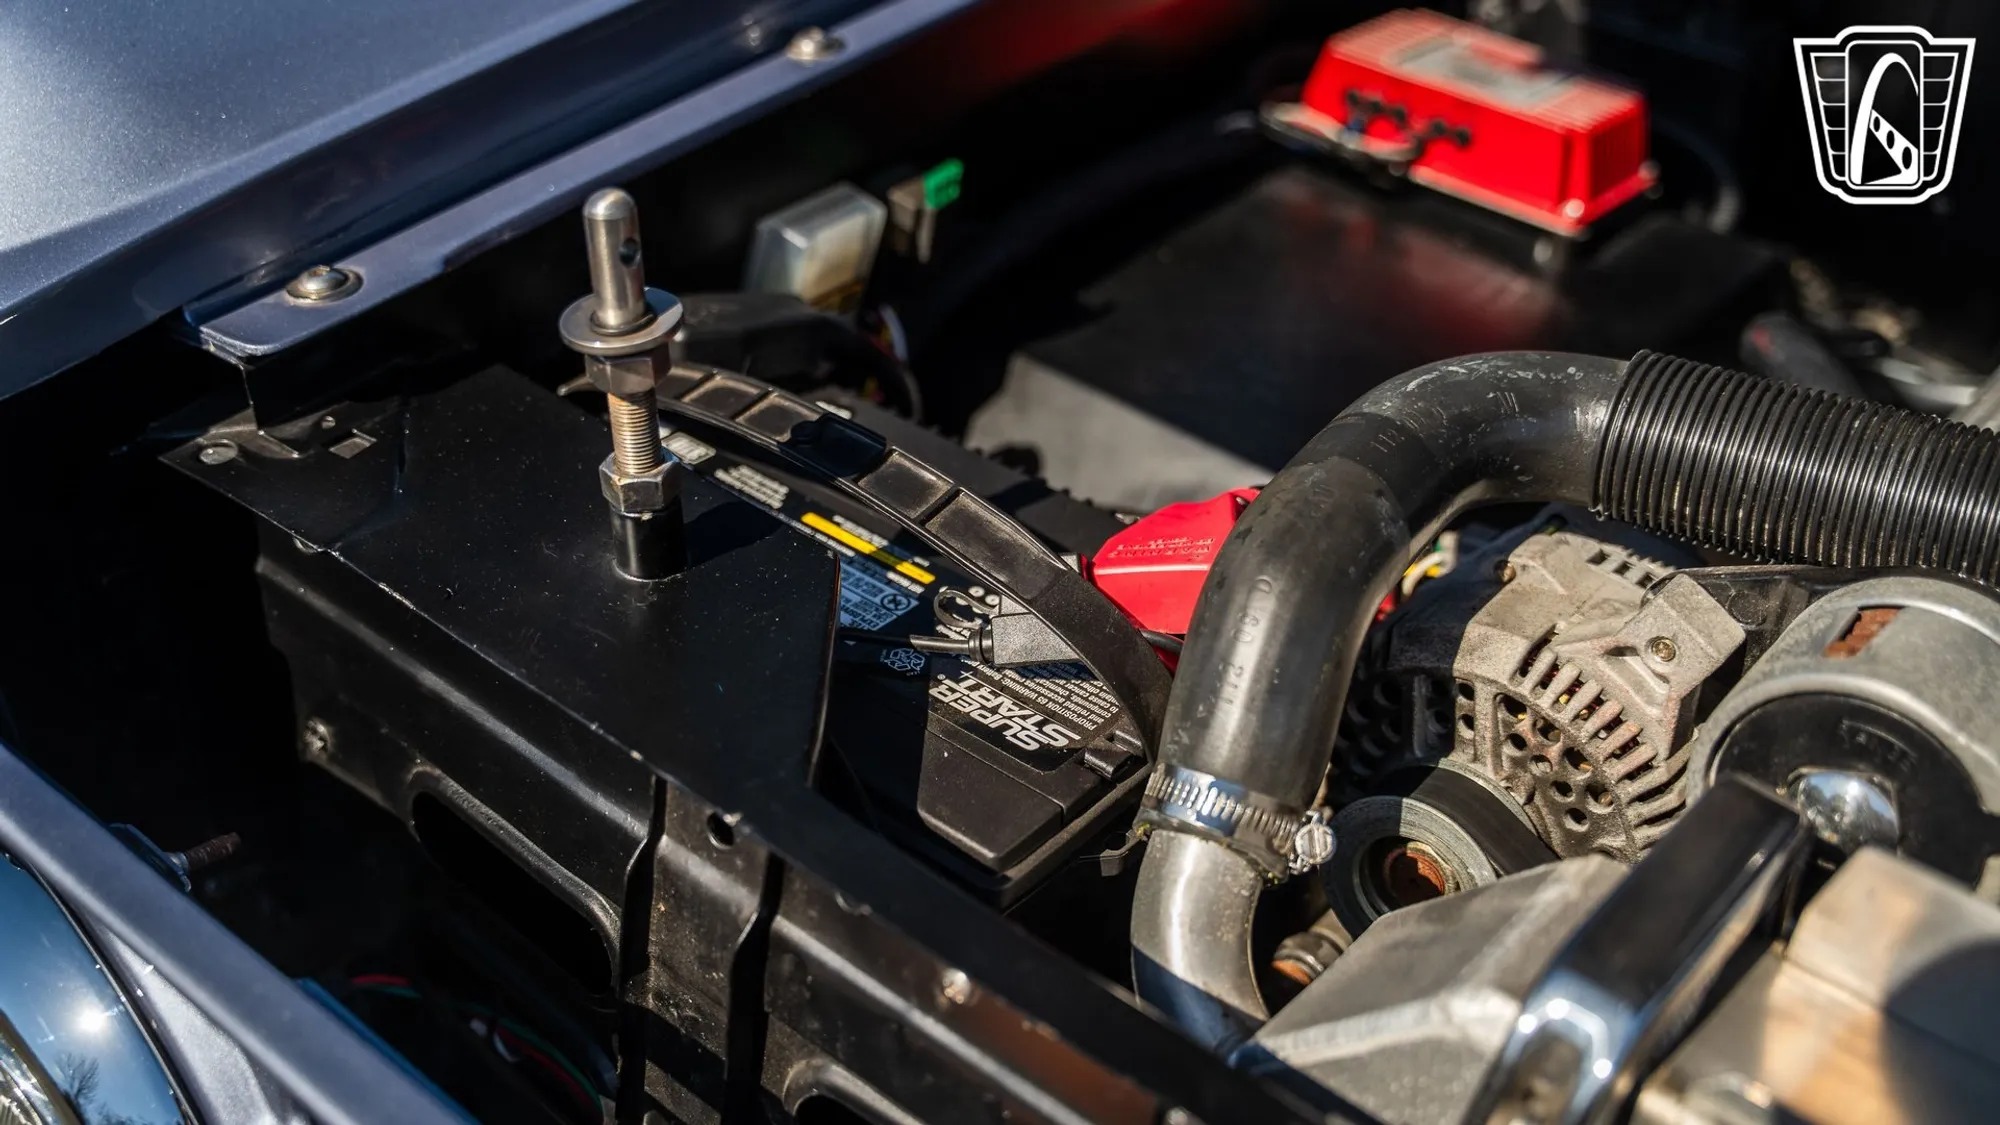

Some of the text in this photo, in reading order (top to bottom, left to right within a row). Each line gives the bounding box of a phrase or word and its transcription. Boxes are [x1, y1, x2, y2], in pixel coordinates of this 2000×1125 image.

[976, 663, 1002, 680] Battery
[1001, 668, 1025, 682] contai
[1000, 676, 1038, 700] WARNING:
[1023, 679, 1065, 703] accessories
[1063, 682, 1089, 697] cancer
[1079, 681, 1100, 694] other
[1035, 695, 1048, 704] 65
[1087, 694, 1110, 708] cause
[1045, 700, 1097, 730] PROPOSITION
[1062, 700, 1090, 716] related
[1108, 705, 1119, 713] to
[928, 683, 1050, 750] SUPER
[1086, 713, 1104, 724] and
